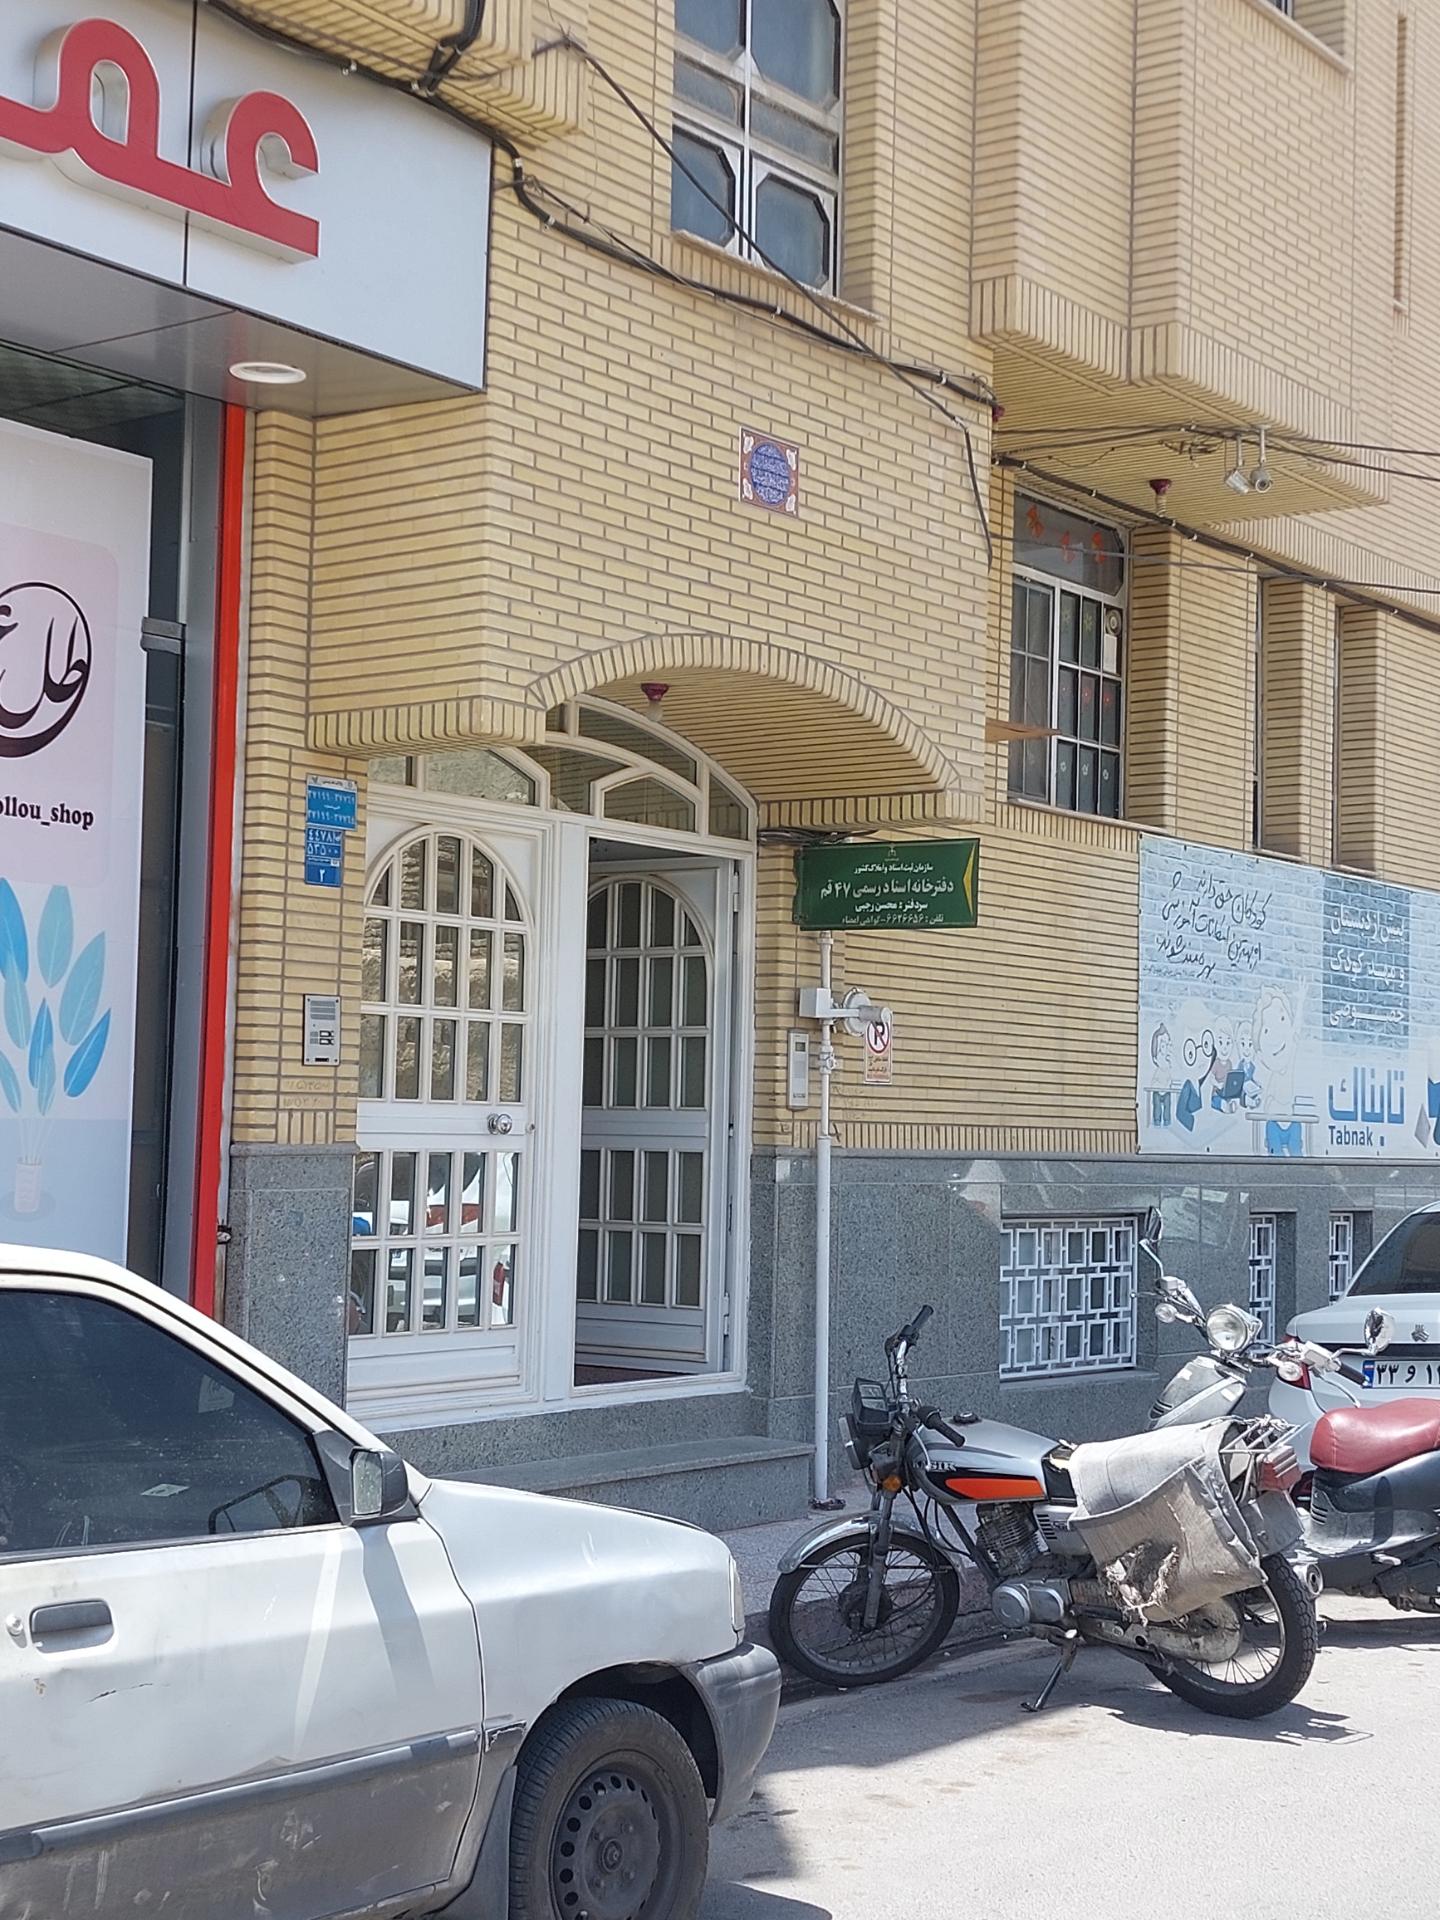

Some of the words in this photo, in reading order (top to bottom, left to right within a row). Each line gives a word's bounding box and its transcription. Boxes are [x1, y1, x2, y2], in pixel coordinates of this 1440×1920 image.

[0, 17, 319, 258] عم
[888, 863, 903, 871] اسناد
[913, 862, 934, 873] سازمان
[820, 879, 833, 900] قم
[834, 881, 851, 899] ۴۷
[852, 884, 881, 899] رسمی
[883, 878, 911, 893] اسناد
[911, 876, 954, 897] دفترخانه
[854, 901, 876, 912] رجبی
[875, 902, 898, 912] محسن
[1331, 903, 1371, 937] دبستان
[1329, 1001, 1405, 1026] خصوصی
[1328, 1125, 1373, 1147] Tabnak
[1376, 1363, 1400, 1385] ۳۳
